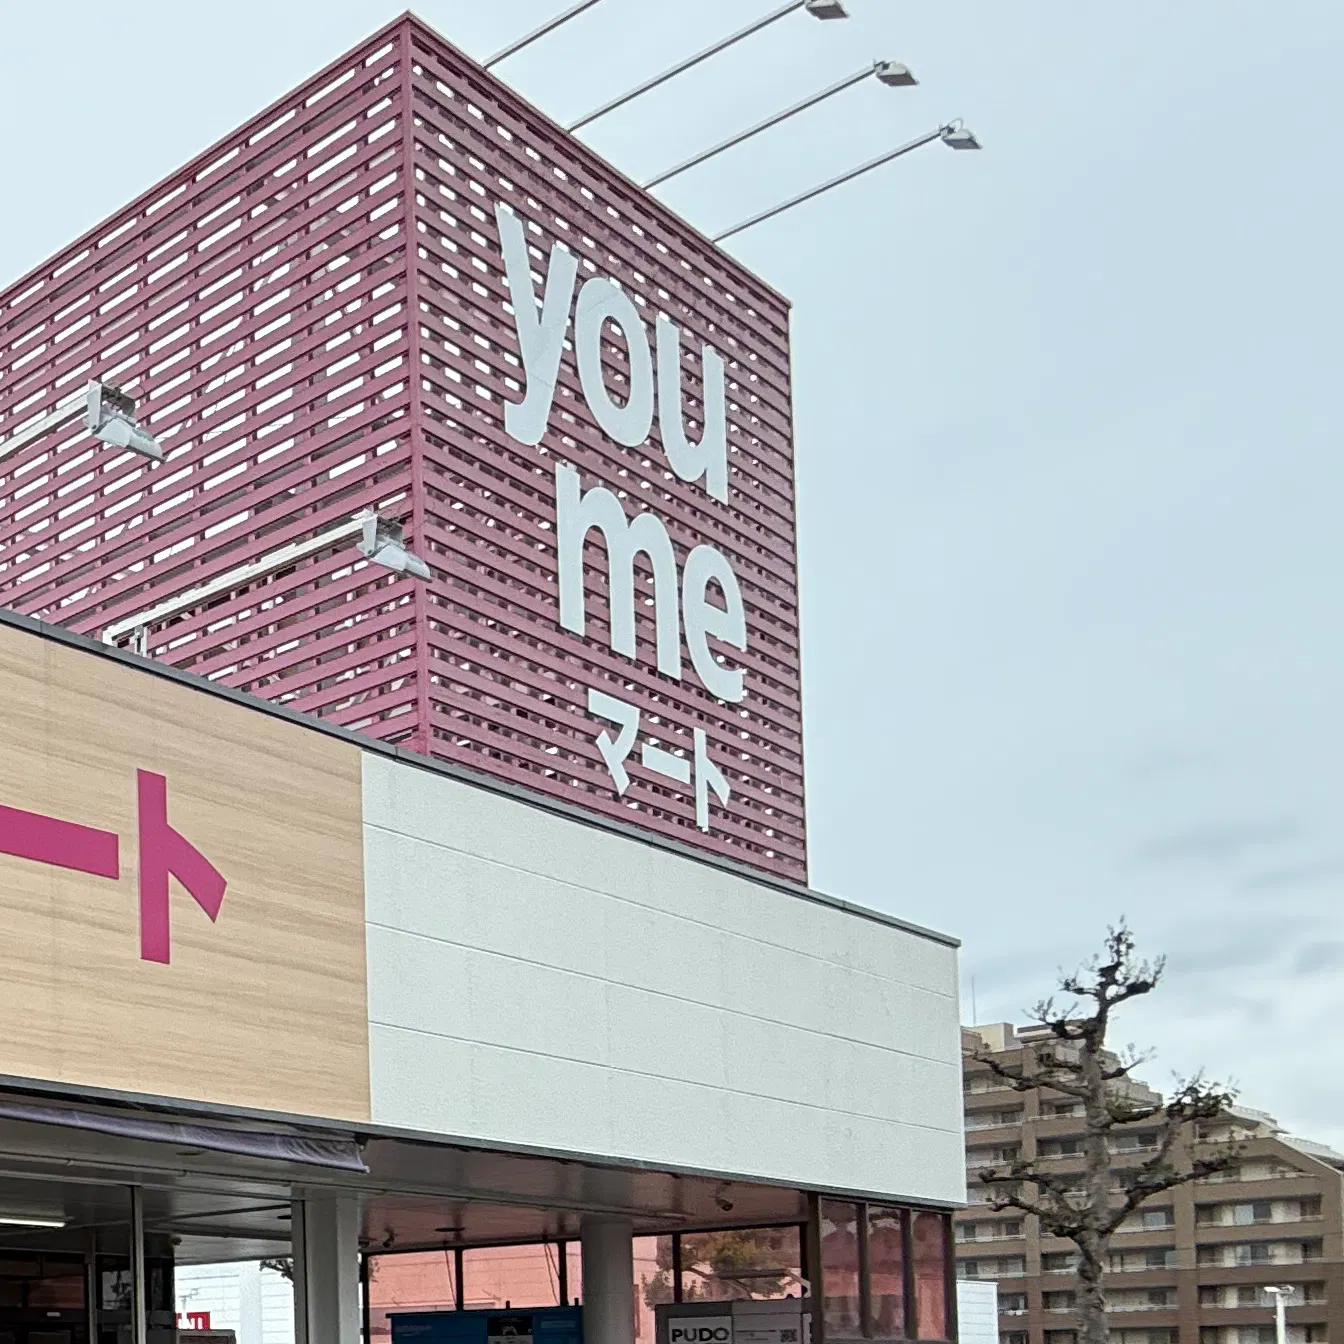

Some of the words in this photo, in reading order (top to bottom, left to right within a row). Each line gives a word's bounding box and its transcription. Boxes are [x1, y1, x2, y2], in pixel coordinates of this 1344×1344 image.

[494, 201, 729, 505] you
[555, 459, 747, 702] me
[588, 688, 736, 832] マート
[672, 1327, 730, 1342] PUDO
